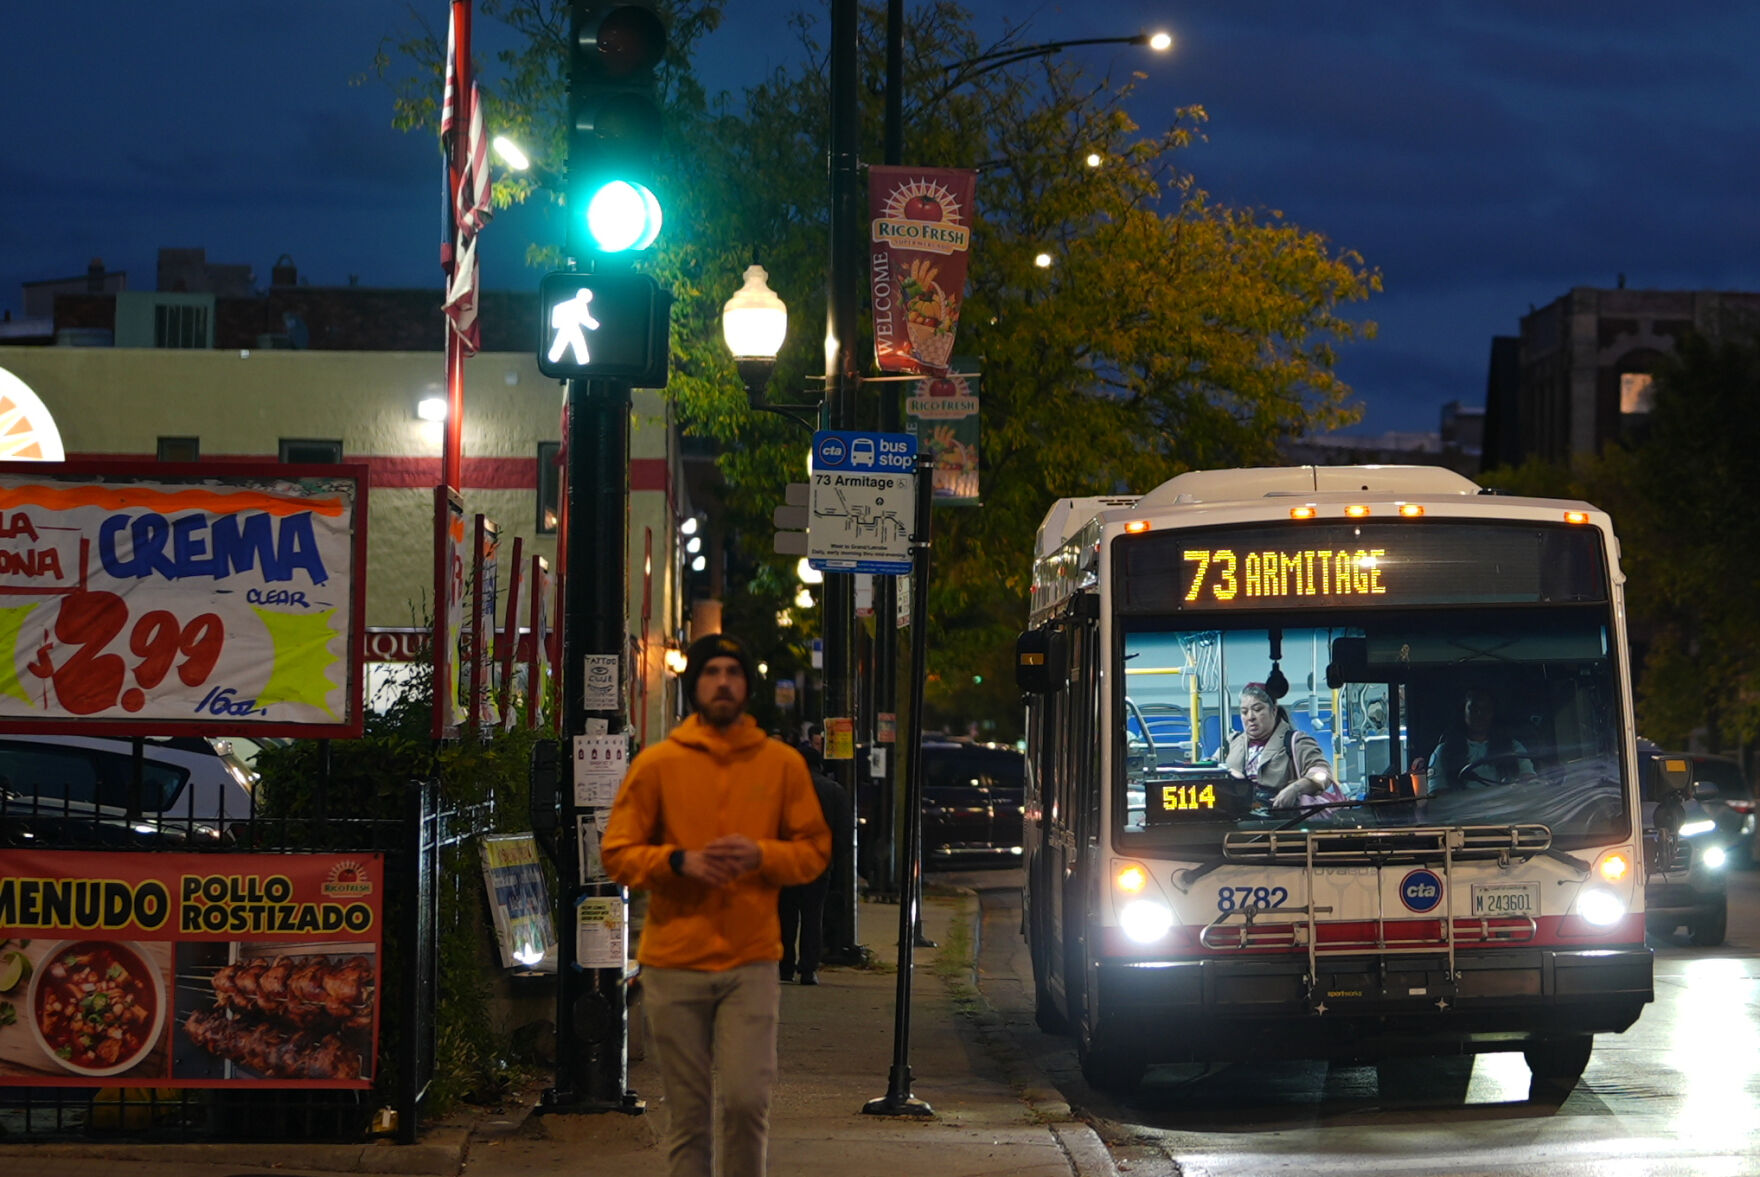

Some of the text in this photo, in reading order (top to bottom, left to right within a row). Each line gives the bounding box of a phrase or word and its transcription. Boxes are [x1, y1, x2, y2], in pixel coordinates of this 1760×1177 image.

[879, 222, 964, 245] RICO FRESH
[873, 251, 893, 355] WELCOME
[911, 400, 975, 410] RICO FRESH
[879, 438, 907, 453] bus
[879, 453, 913, 470] stop
[816, 474, 894, 491] 73 Armitage
[99, 511, 329, 586] CREMA
[1184, 549, 1386, 600] 73 ARMITAGE
[27, 590, 225, 715] $2.99
[1162, 784, 1216, 811] 5114
[181, 875, 292, 904] POLLO
[1217, 886, 1289, 912] 8782
[1406, 884, 1436, 898] cta
[1488, 894, 1532, 911] 243601
[181, 902, 374, 933] ROSTIZADO
